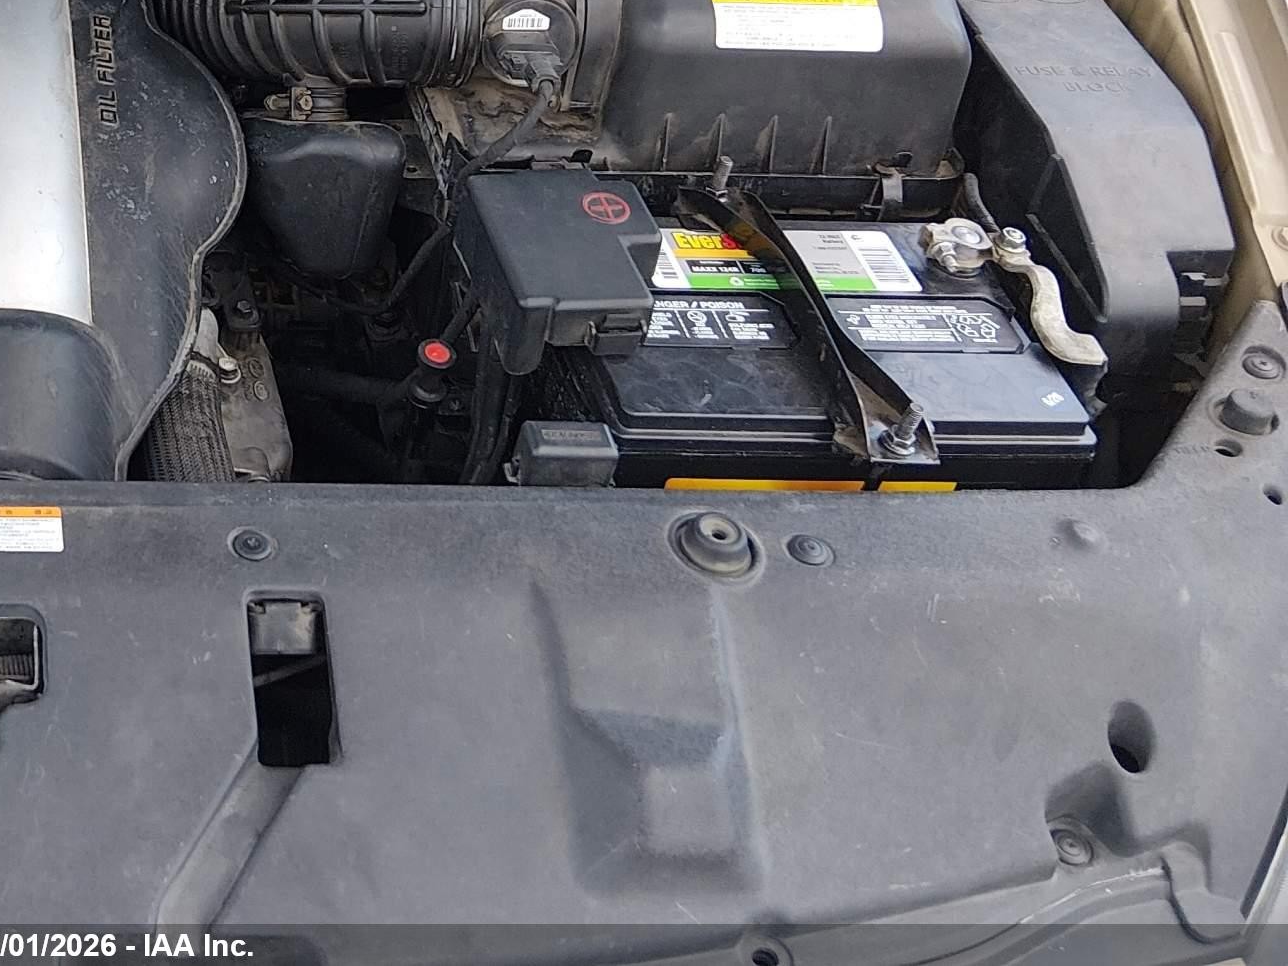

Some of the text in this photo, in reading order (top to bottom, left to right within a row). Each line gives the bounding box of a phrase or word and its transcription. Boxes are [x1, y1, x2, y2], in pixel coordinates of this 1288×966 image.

[93, 14, 118, 127] OIL FILTER
[1015, 65, 1062, 76] FUSE
[1090, 66, 1152, 77] RELAY
[699, 301, 745, 309] POISON
